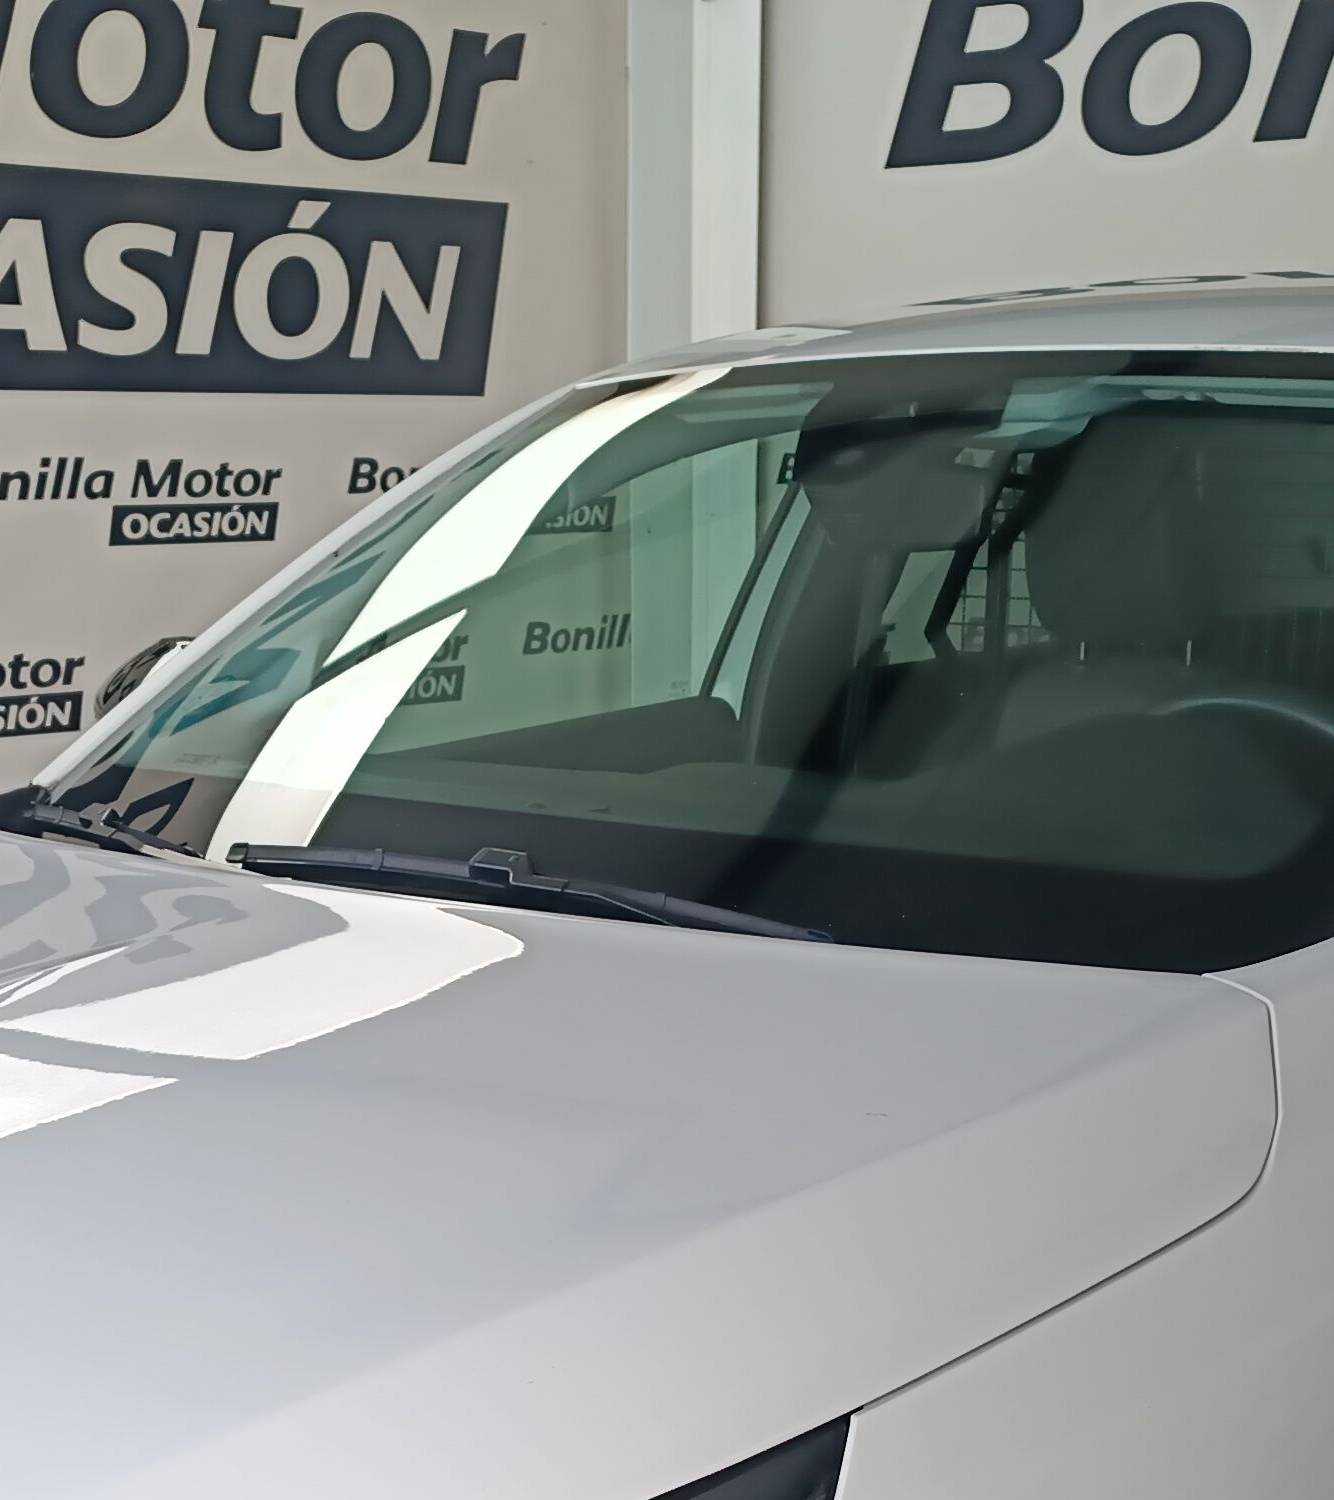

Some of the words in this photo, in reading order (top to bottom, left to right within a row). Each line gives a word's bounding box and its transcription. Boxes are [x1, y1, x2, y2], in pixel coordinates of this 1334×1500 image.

[131, 459, 282, 498] Motor
[122, 505, 269, 539] OCASIÓN
[522, 614, 631, 656] Bonill
